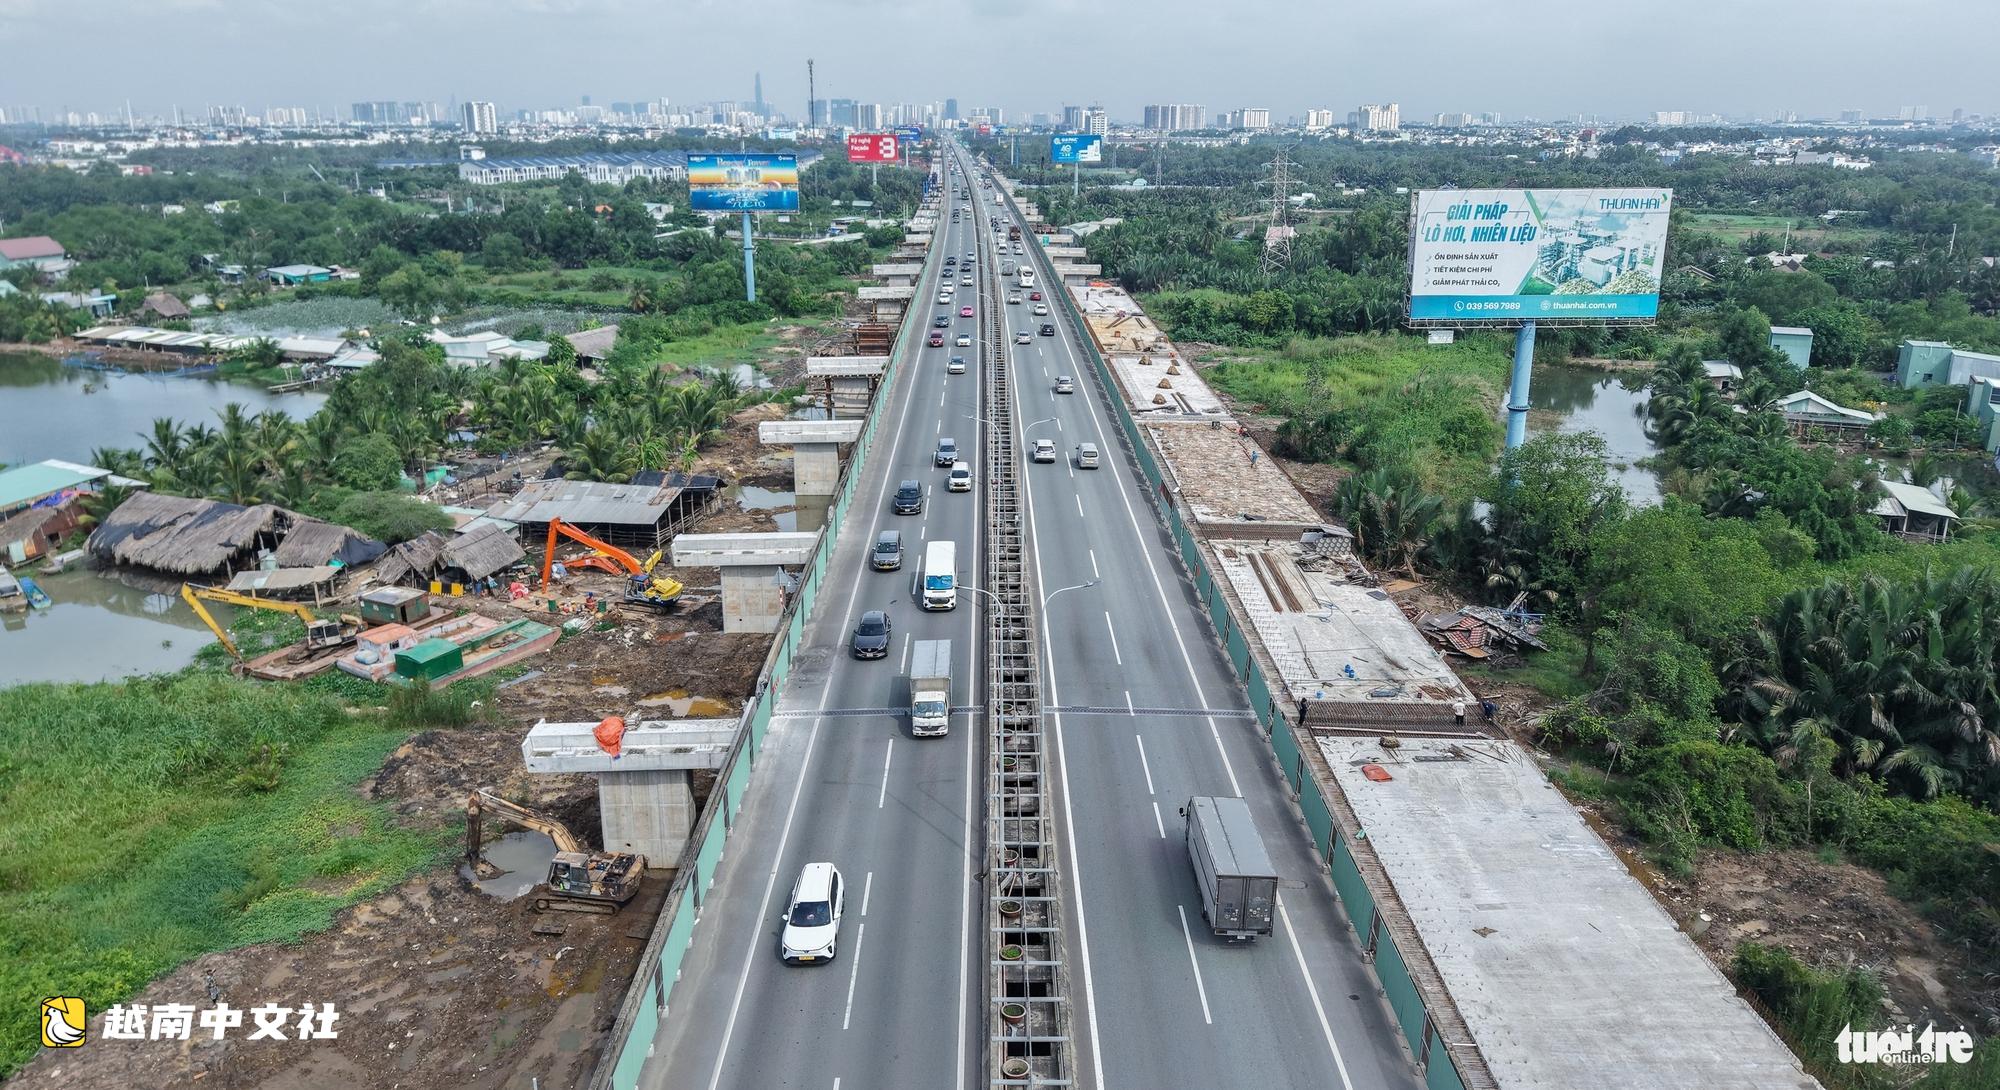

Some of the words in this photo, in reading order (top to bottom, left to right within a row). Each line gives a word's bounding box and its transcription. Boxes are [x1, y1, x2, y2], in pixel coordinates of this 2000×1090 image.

[1447, 200, 1472, 220] GIẢI
[1474, 201, 1508, 220] PHÁP
[1424, 224, 1441, 242] LÒ
[1443, 225, 1466, 244] HƠI,
[1471, 223, 1508, 242] NHIÊN
[1509, 223, 1537, 245] LIỆU
[1466, 302, 1482, 310] 039
[1484, 302, 1499, 310] 569
[1500, 302, 1520, 310] 7989
[1553, 302, 1617, 310] thuanhai.com.vn
